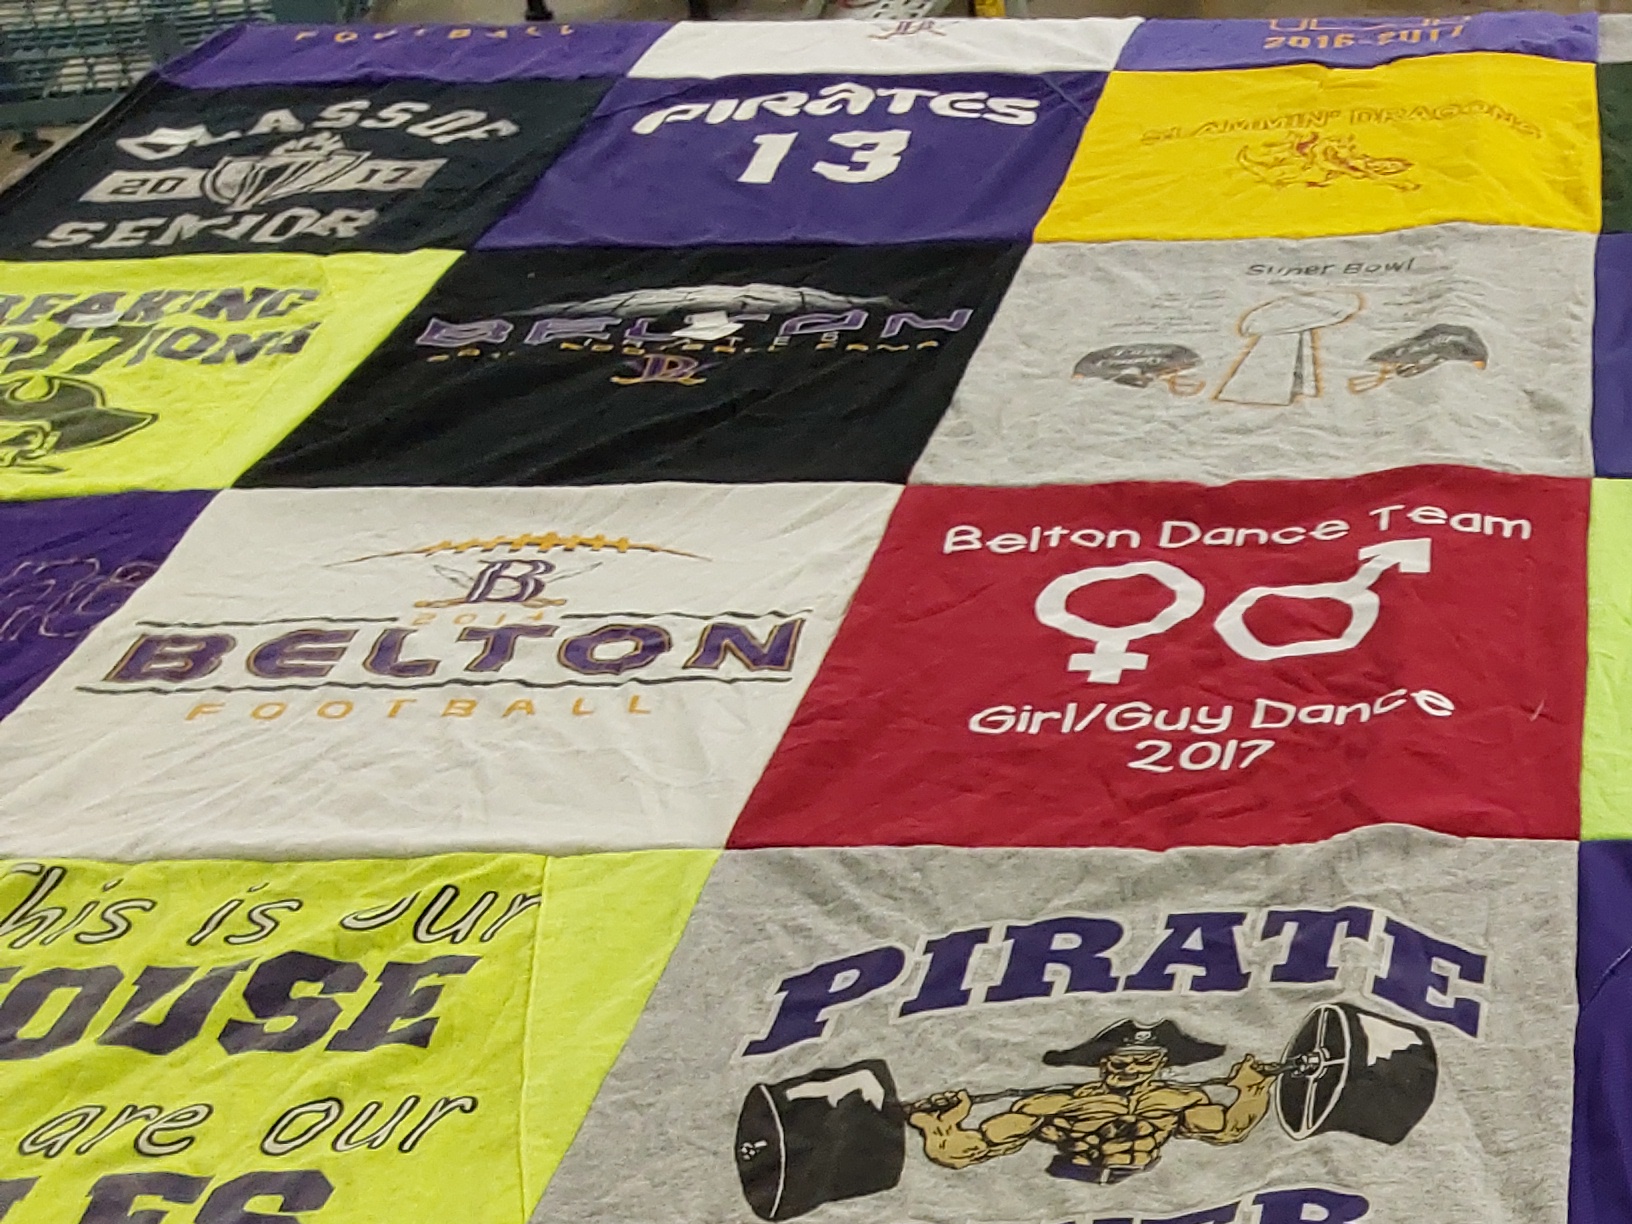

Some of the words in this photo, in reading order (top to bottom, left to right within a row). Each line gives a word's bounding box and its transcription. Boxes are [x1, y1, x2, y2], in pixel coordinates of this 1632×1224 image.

[631, 82, 1041, 135] PIRATES
[737, 130, 911, 184] 13
[109, 177, 186, 195] 20
[31, 207, 380, 250] SENIOR
[1343, 257, 1416, 275] Bowl
[415, 309, 974, 347] BELON
[943, 524, 1140, 554] Belton
[1159, 516, 1349, 550] Dance
[1369, 504, 1532, 541] Team
[101, 618, 807, 682] BELTON
[184, 694, 652, 721] FOOTBALL
[967, 700, 1233, 735] Girl/Guy
[1250, 688, 1455, 730] Dance
[1127, 739, 1275, 773] 2017
[187, 882, 303, 947] is
[0, 949, 483, 1061] OUSE
[732, 903, 1495, 1062] PIRATE
[18, 1101, 214, 1158] are
[259, 1094, 479, 1156] our
